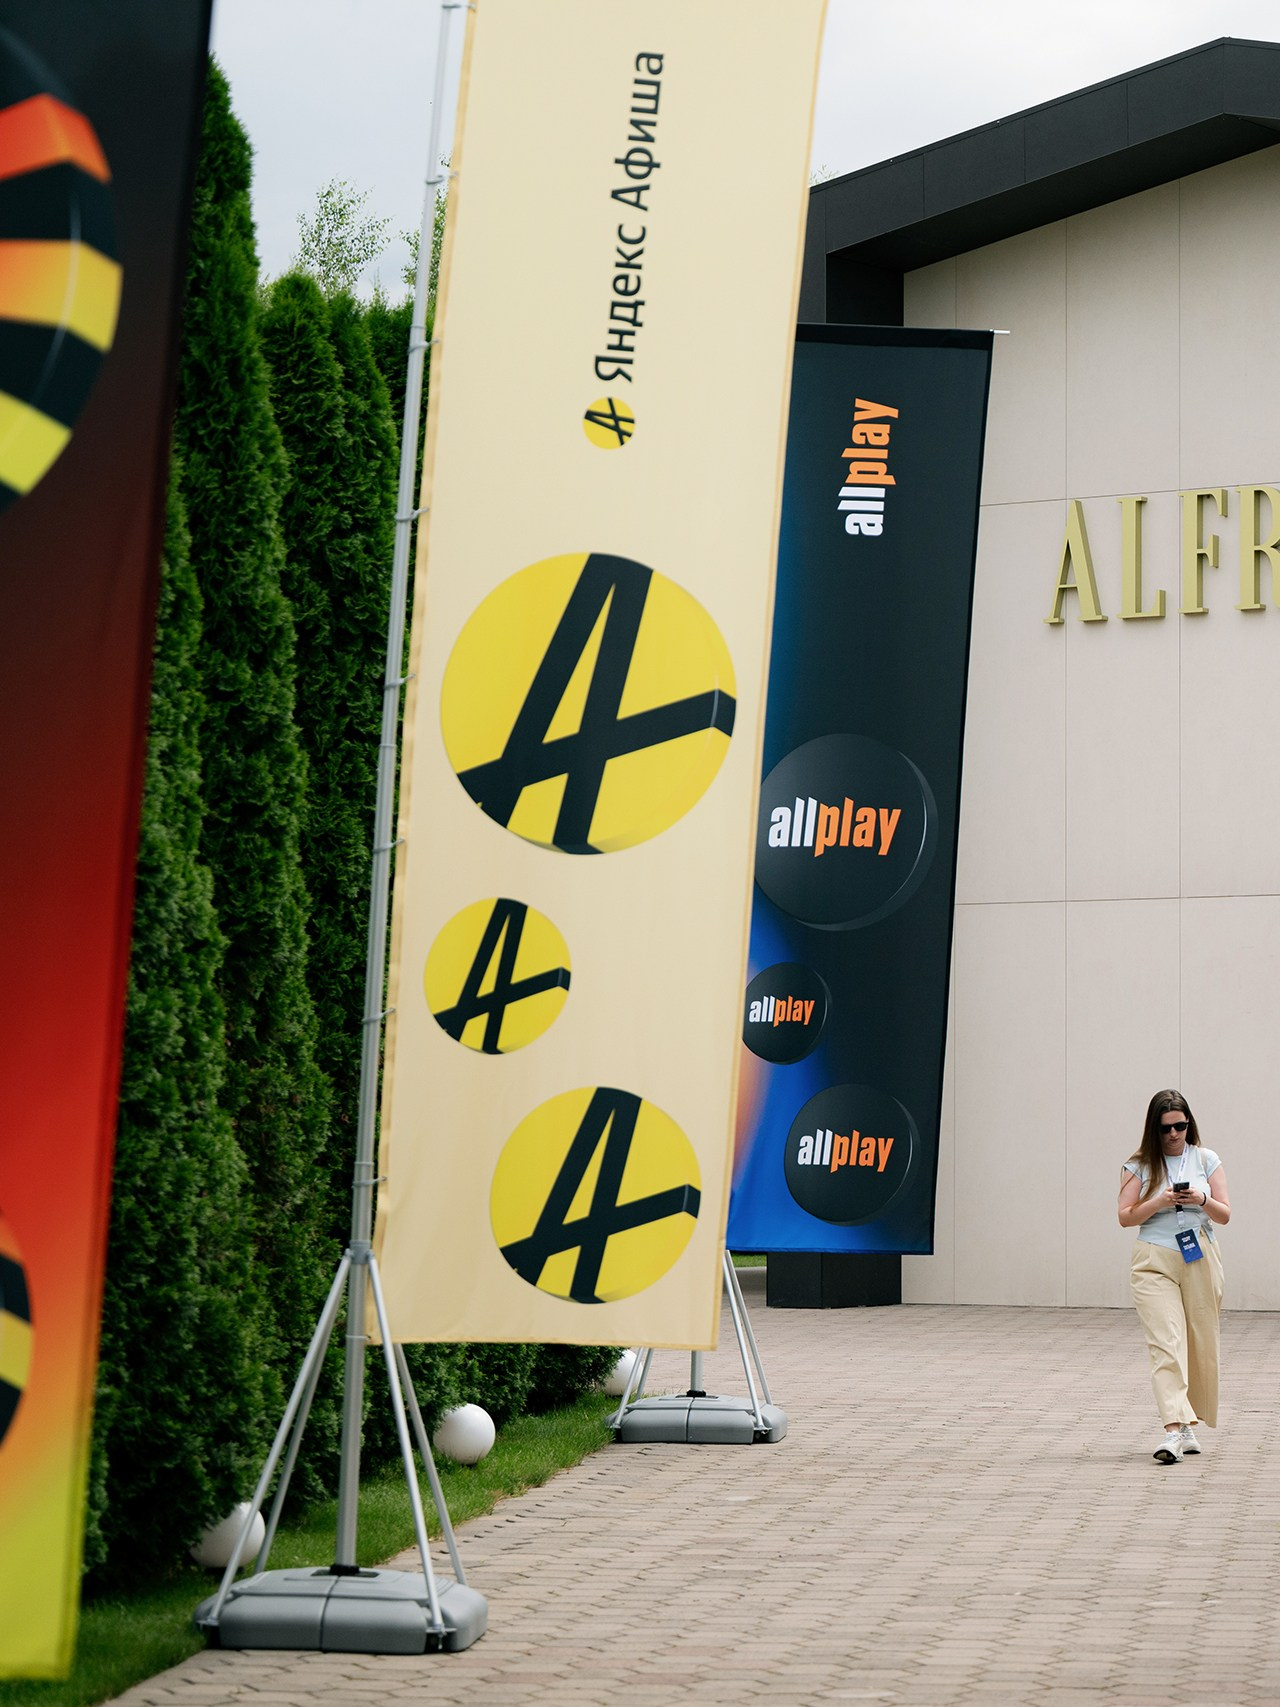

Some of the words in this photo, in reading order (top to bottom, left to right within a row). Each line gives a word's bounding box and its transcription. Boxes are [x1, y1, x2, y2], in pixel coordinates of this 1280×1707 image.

[610, 51, 665, 212] Афиша
[594, 223, 647, 383] Яндекс
[837, 397, 899, 536] allplay
[768, 796, 902, 857] allplay
[748, 995, 815, 1027] allplay
[797, 1128, 894, 1173] allplay
